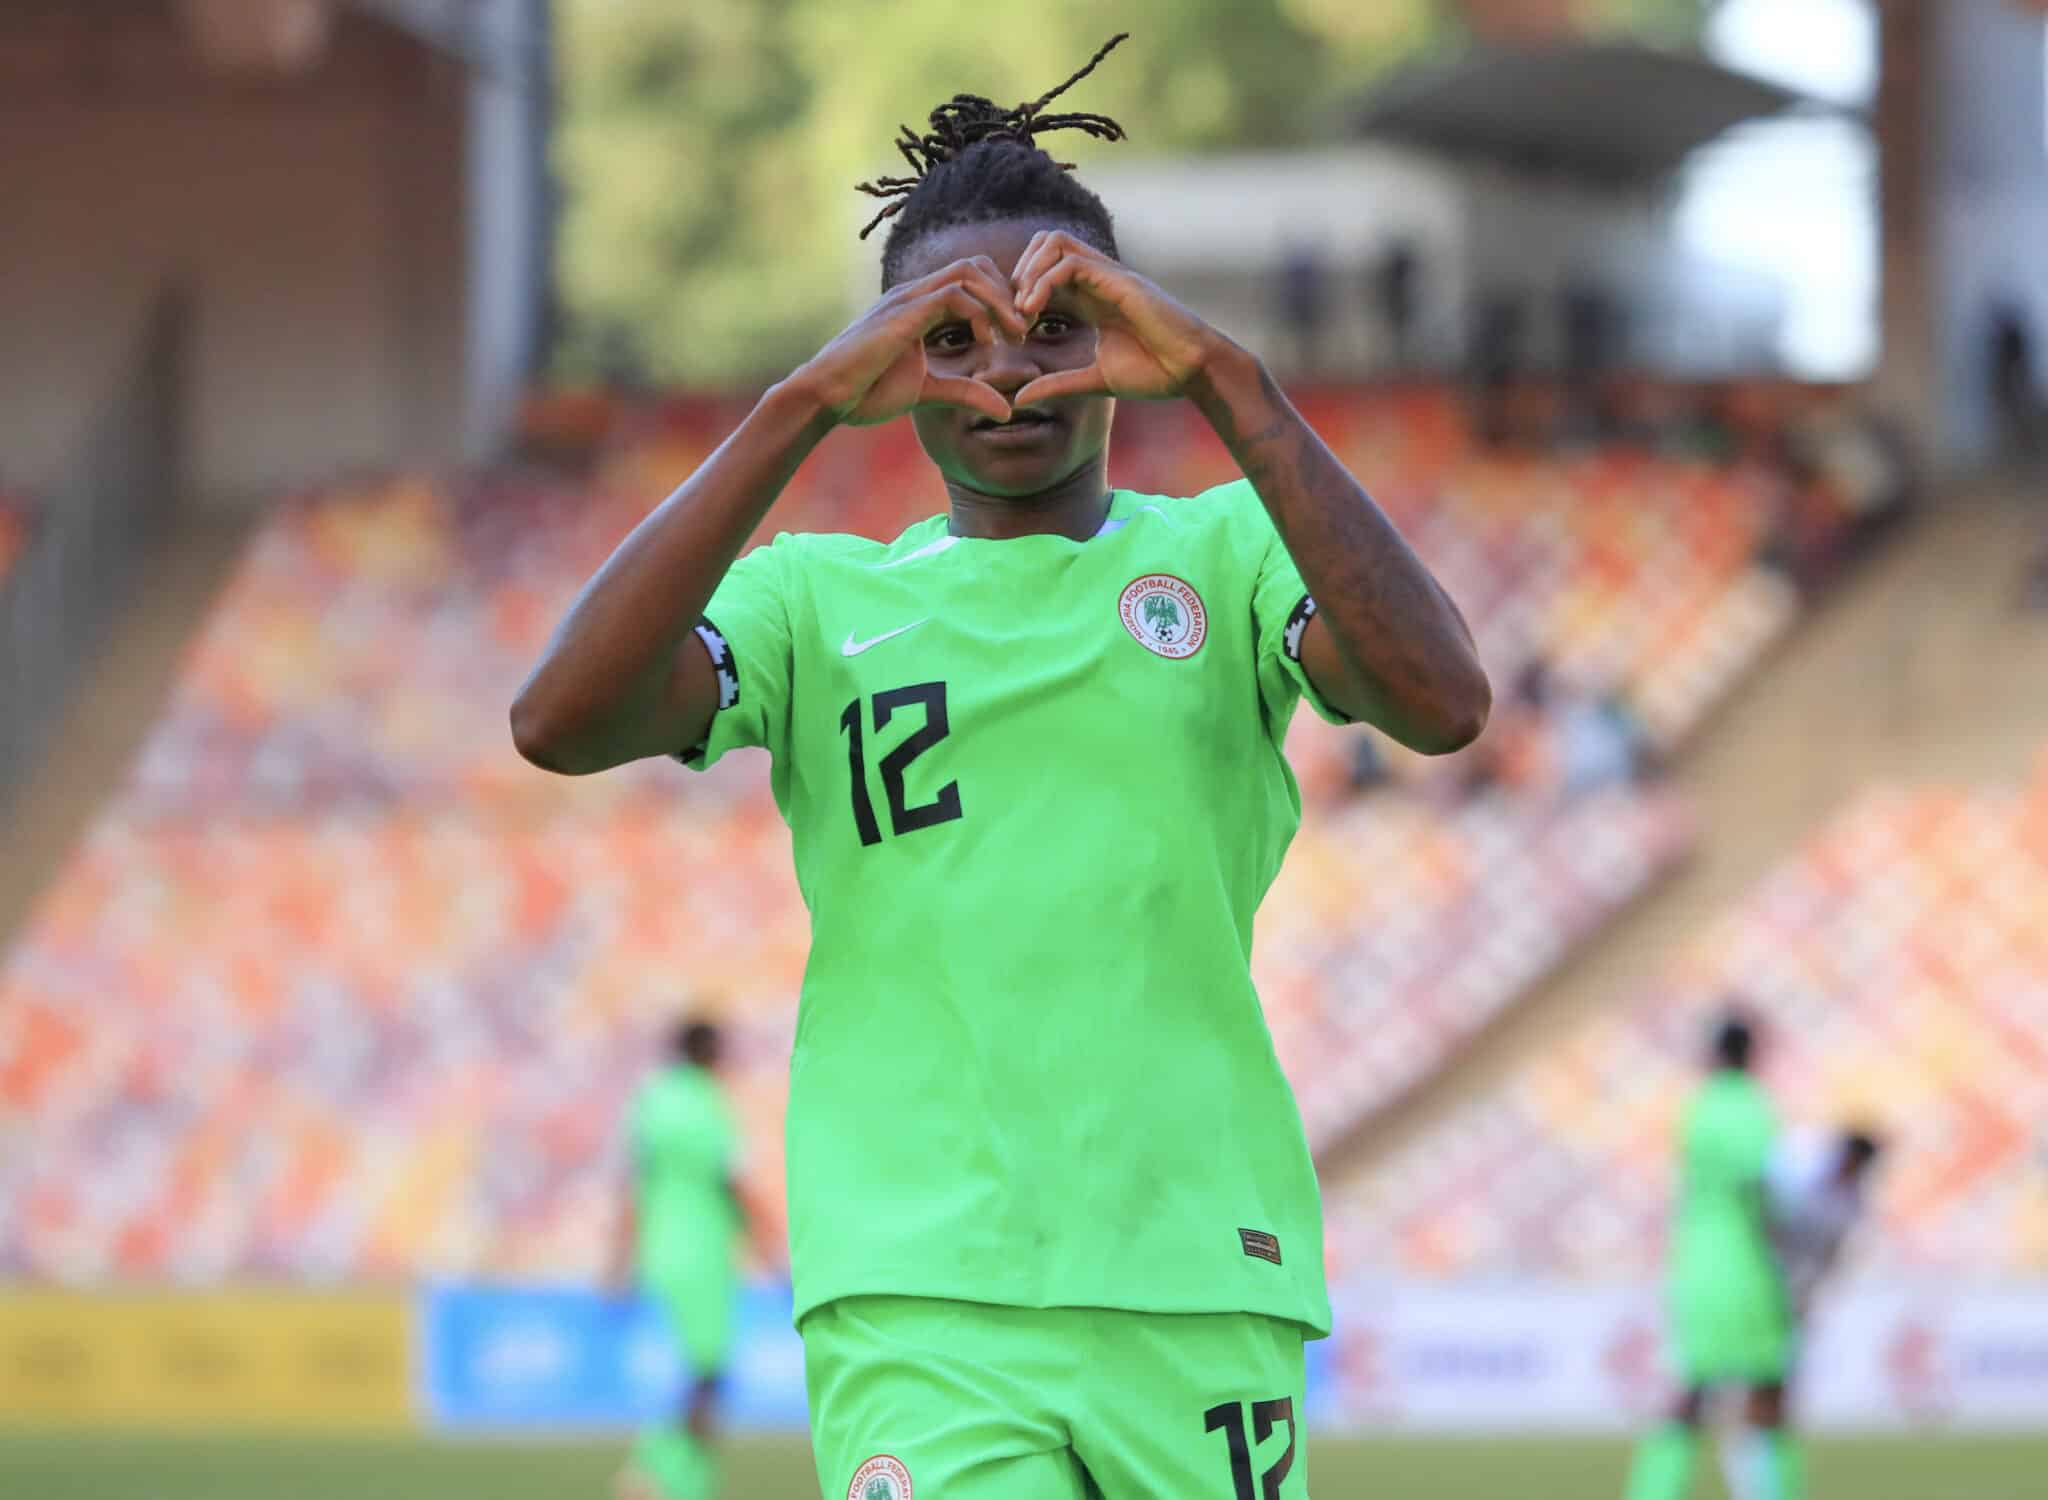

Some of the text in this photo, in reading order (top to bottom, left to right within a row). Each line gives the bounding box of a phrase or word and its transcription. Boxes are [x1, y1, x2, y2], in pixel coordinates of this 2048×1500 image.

[1126, 579, 1175, 601] FOOTBALL
[1177, 586, 1202, 647] FEDERATION
[840, 680, 963, 847] 12
[1203, 1395, 1296, 1500] 12
